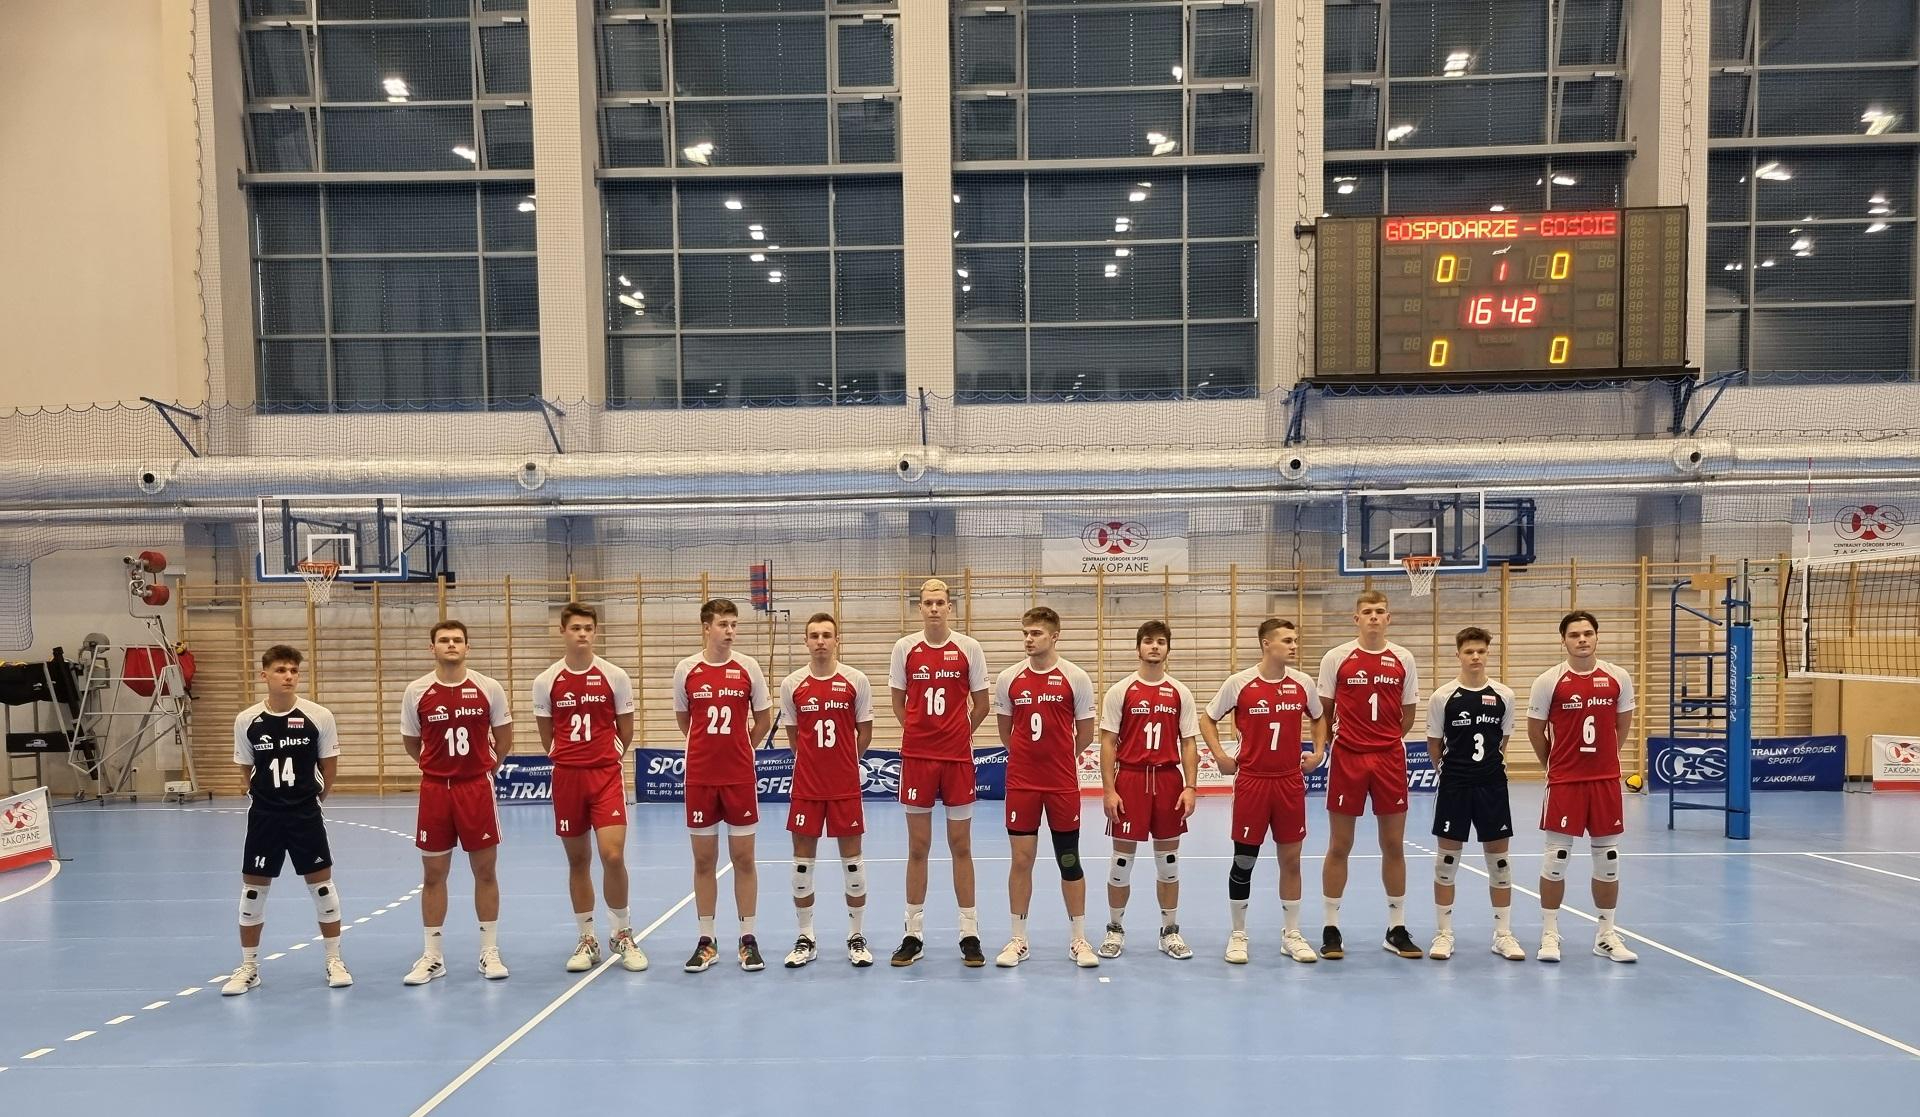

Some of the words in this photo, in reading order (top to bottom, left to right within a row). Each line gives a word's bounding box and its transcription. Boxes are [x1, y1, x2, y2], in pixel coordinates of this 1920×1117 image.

[1386, 219, 1518, 241] GOSPODARZE
[1436, 255, 1456, 282] 0
[1499, 262, 1507, 281] 1
[1550, 252, 1570, 280] 0
[1429, 339, 1449, 367] 0
[1549, 336, 1569, 364] 0
[1082, 562, 1149, 573] ZAKOPANE
[935, 669, 954, 680] plus
[1373, 674, 1393, 685] plus
[581, 693, 599, 705] plus
[718, 687, 739, 698] plus
[1037, 692, 1056, 704] plus
[825, 700, 843, 711] plus
[924, 687, 946, 716] 16
[1275, 701, 1296, 713] plus
[1367, 692, 1378, 722] 1
[1587, 695, 1607, 707] plus
[455, 706, 476, 718] plus
[1154, 703, 1173, 714] plus
[707, 705, 732, 735] 22
[1475, 713, 1495, 725] plus
[570, 713, 592, 742] 21
[814, 719, 836, 748] 13
[1030, 712, 1042, 742] 9
[1582, 715, 1596, 745] 6
[280, 736, 301, 748] plus
[444, 726, 470, 757] 18
[1143, 721, 1162, 750] 11
[1269, 721, 1281, 751] 7
[1471, 733, 1485, 762] 3
[1752, 748, 1788, 756] TRALNY
[1768, 757, 1803, 765] SPORTU
[269, 757, 295, 788] 14
[1763, 775, 1816, 783] ZAKOPANEM
[907, 788, 917, 800] 16
[1338, 794, 1344, 807] 1
[693, 811, 703, 823] 22
[795, 813, 805, 826] 13
[1010, 811, 1016, 823] 9
[1560, 816, 1568, 828] 6
[560, 819, 569, 832] 21
[1122, 821, 1131, 834] 11
[1443, 821, 1450, 833] 3
[2, 830, 41, 847] ZAKOPANE
[420, 830, 427, 843] 18
[1243, 826, 1250, 839] 7
[255, 855, 266, 869] 14
